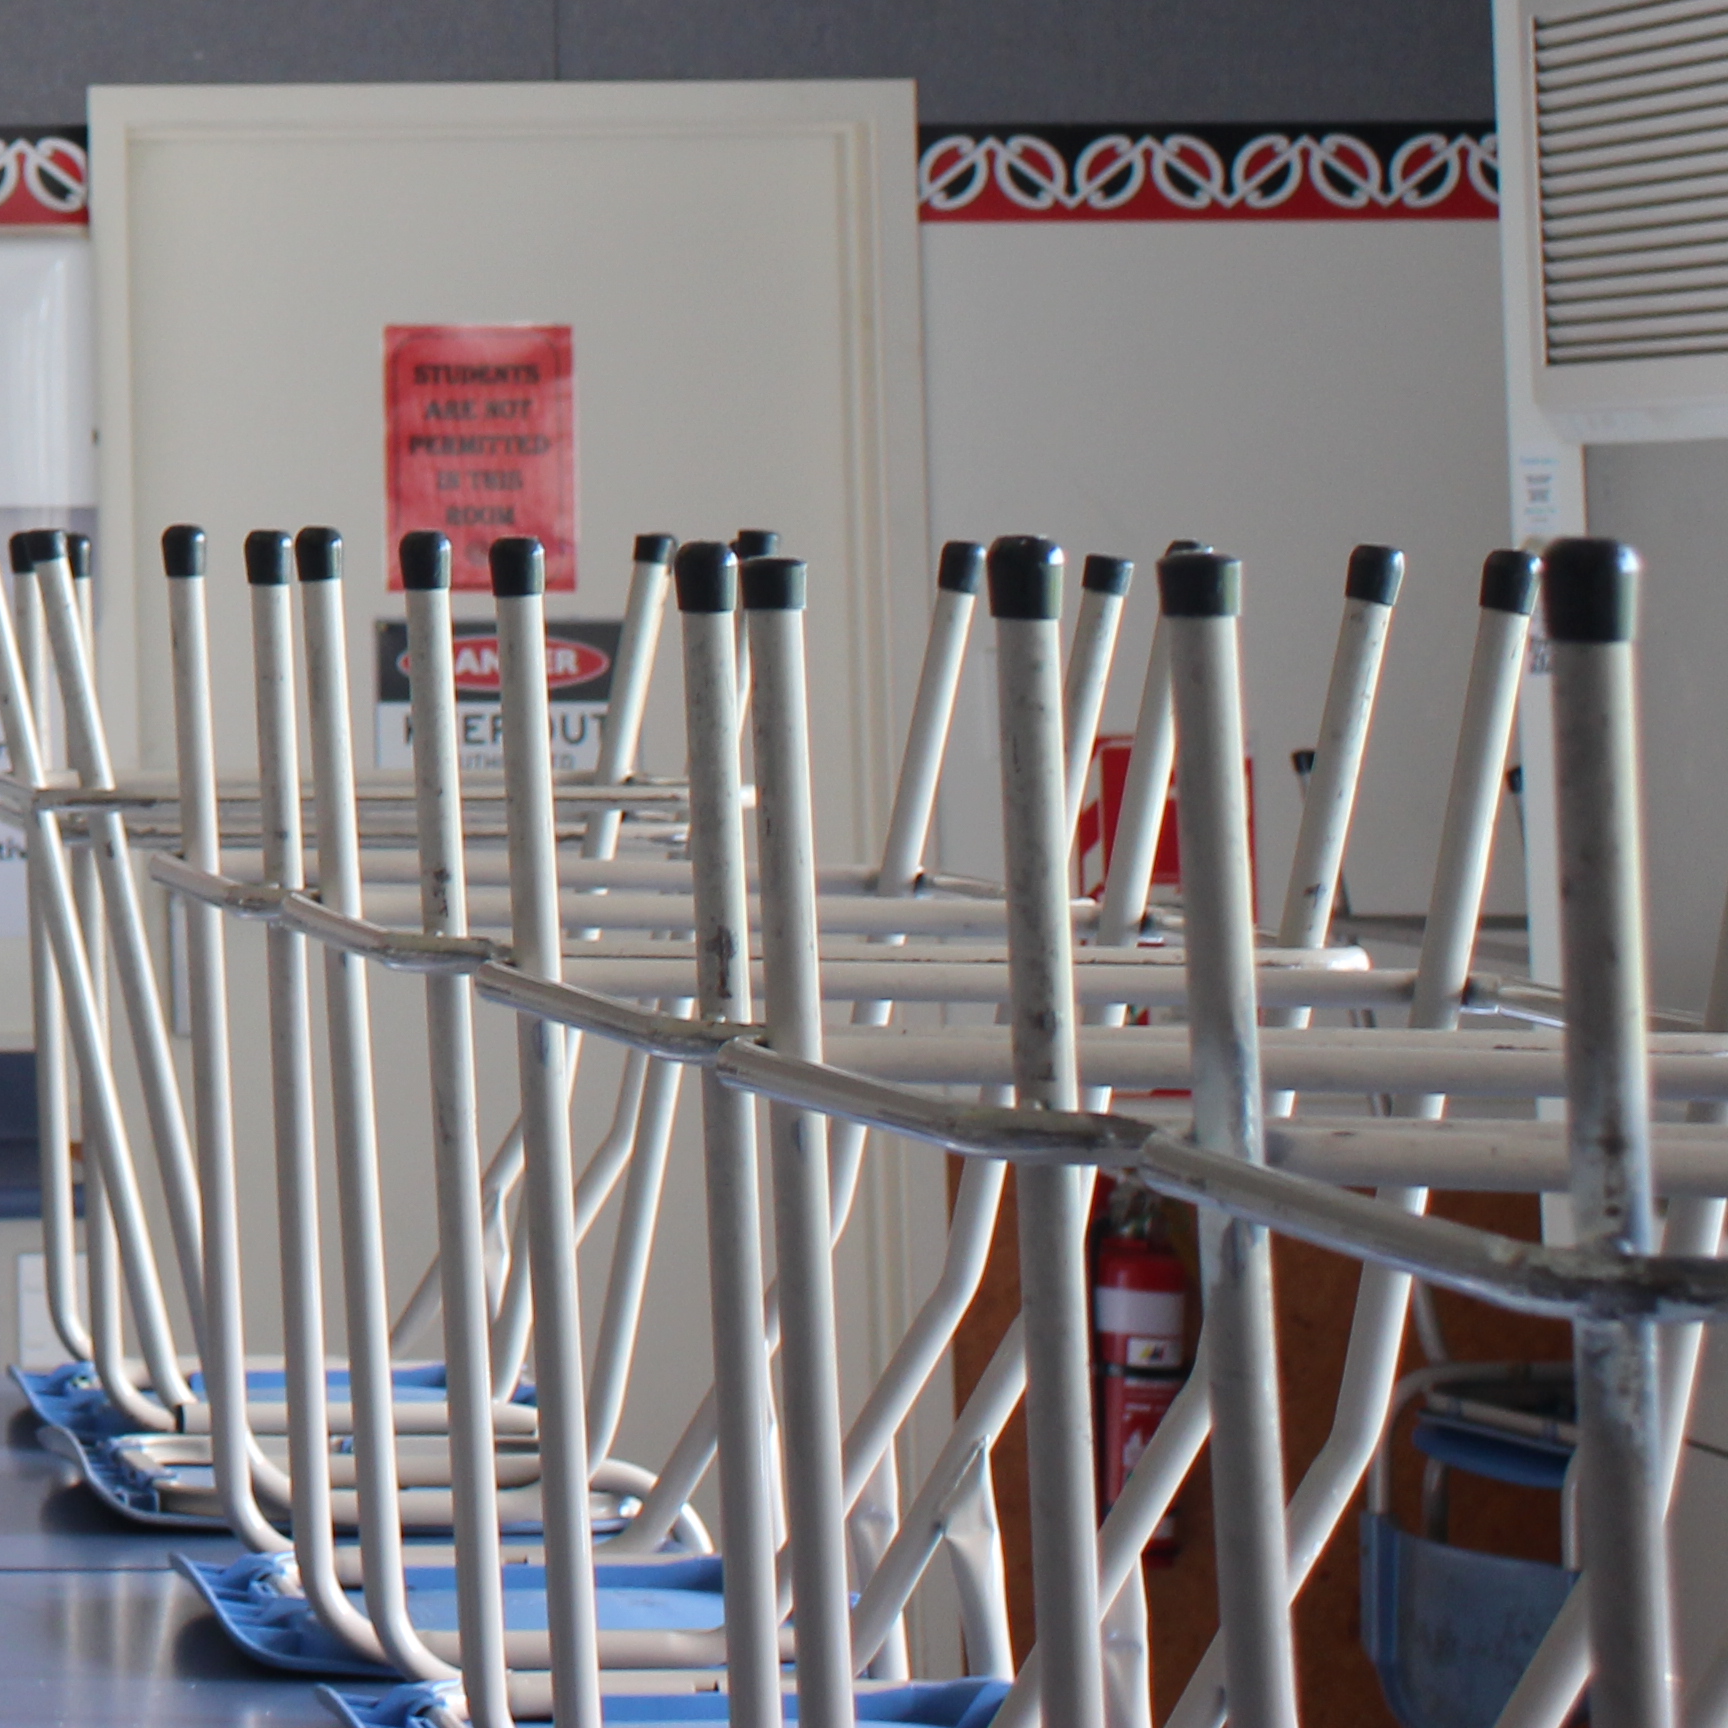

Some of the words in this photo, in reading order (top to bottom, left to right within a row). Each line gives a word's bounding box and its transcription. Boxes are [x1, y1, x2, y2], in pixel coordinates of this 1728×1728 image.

[414, 365, 541, 385] STUDENTS
[425, 400, 477, 420] ARE
[485, 400, 532, 419] NOT
[409, 435, 552, 456] PERMITTED
[437, 470, 460, 490] IN
[467, 470, 524, 490] THIS
[447, 505, 516, 526] ROOM
